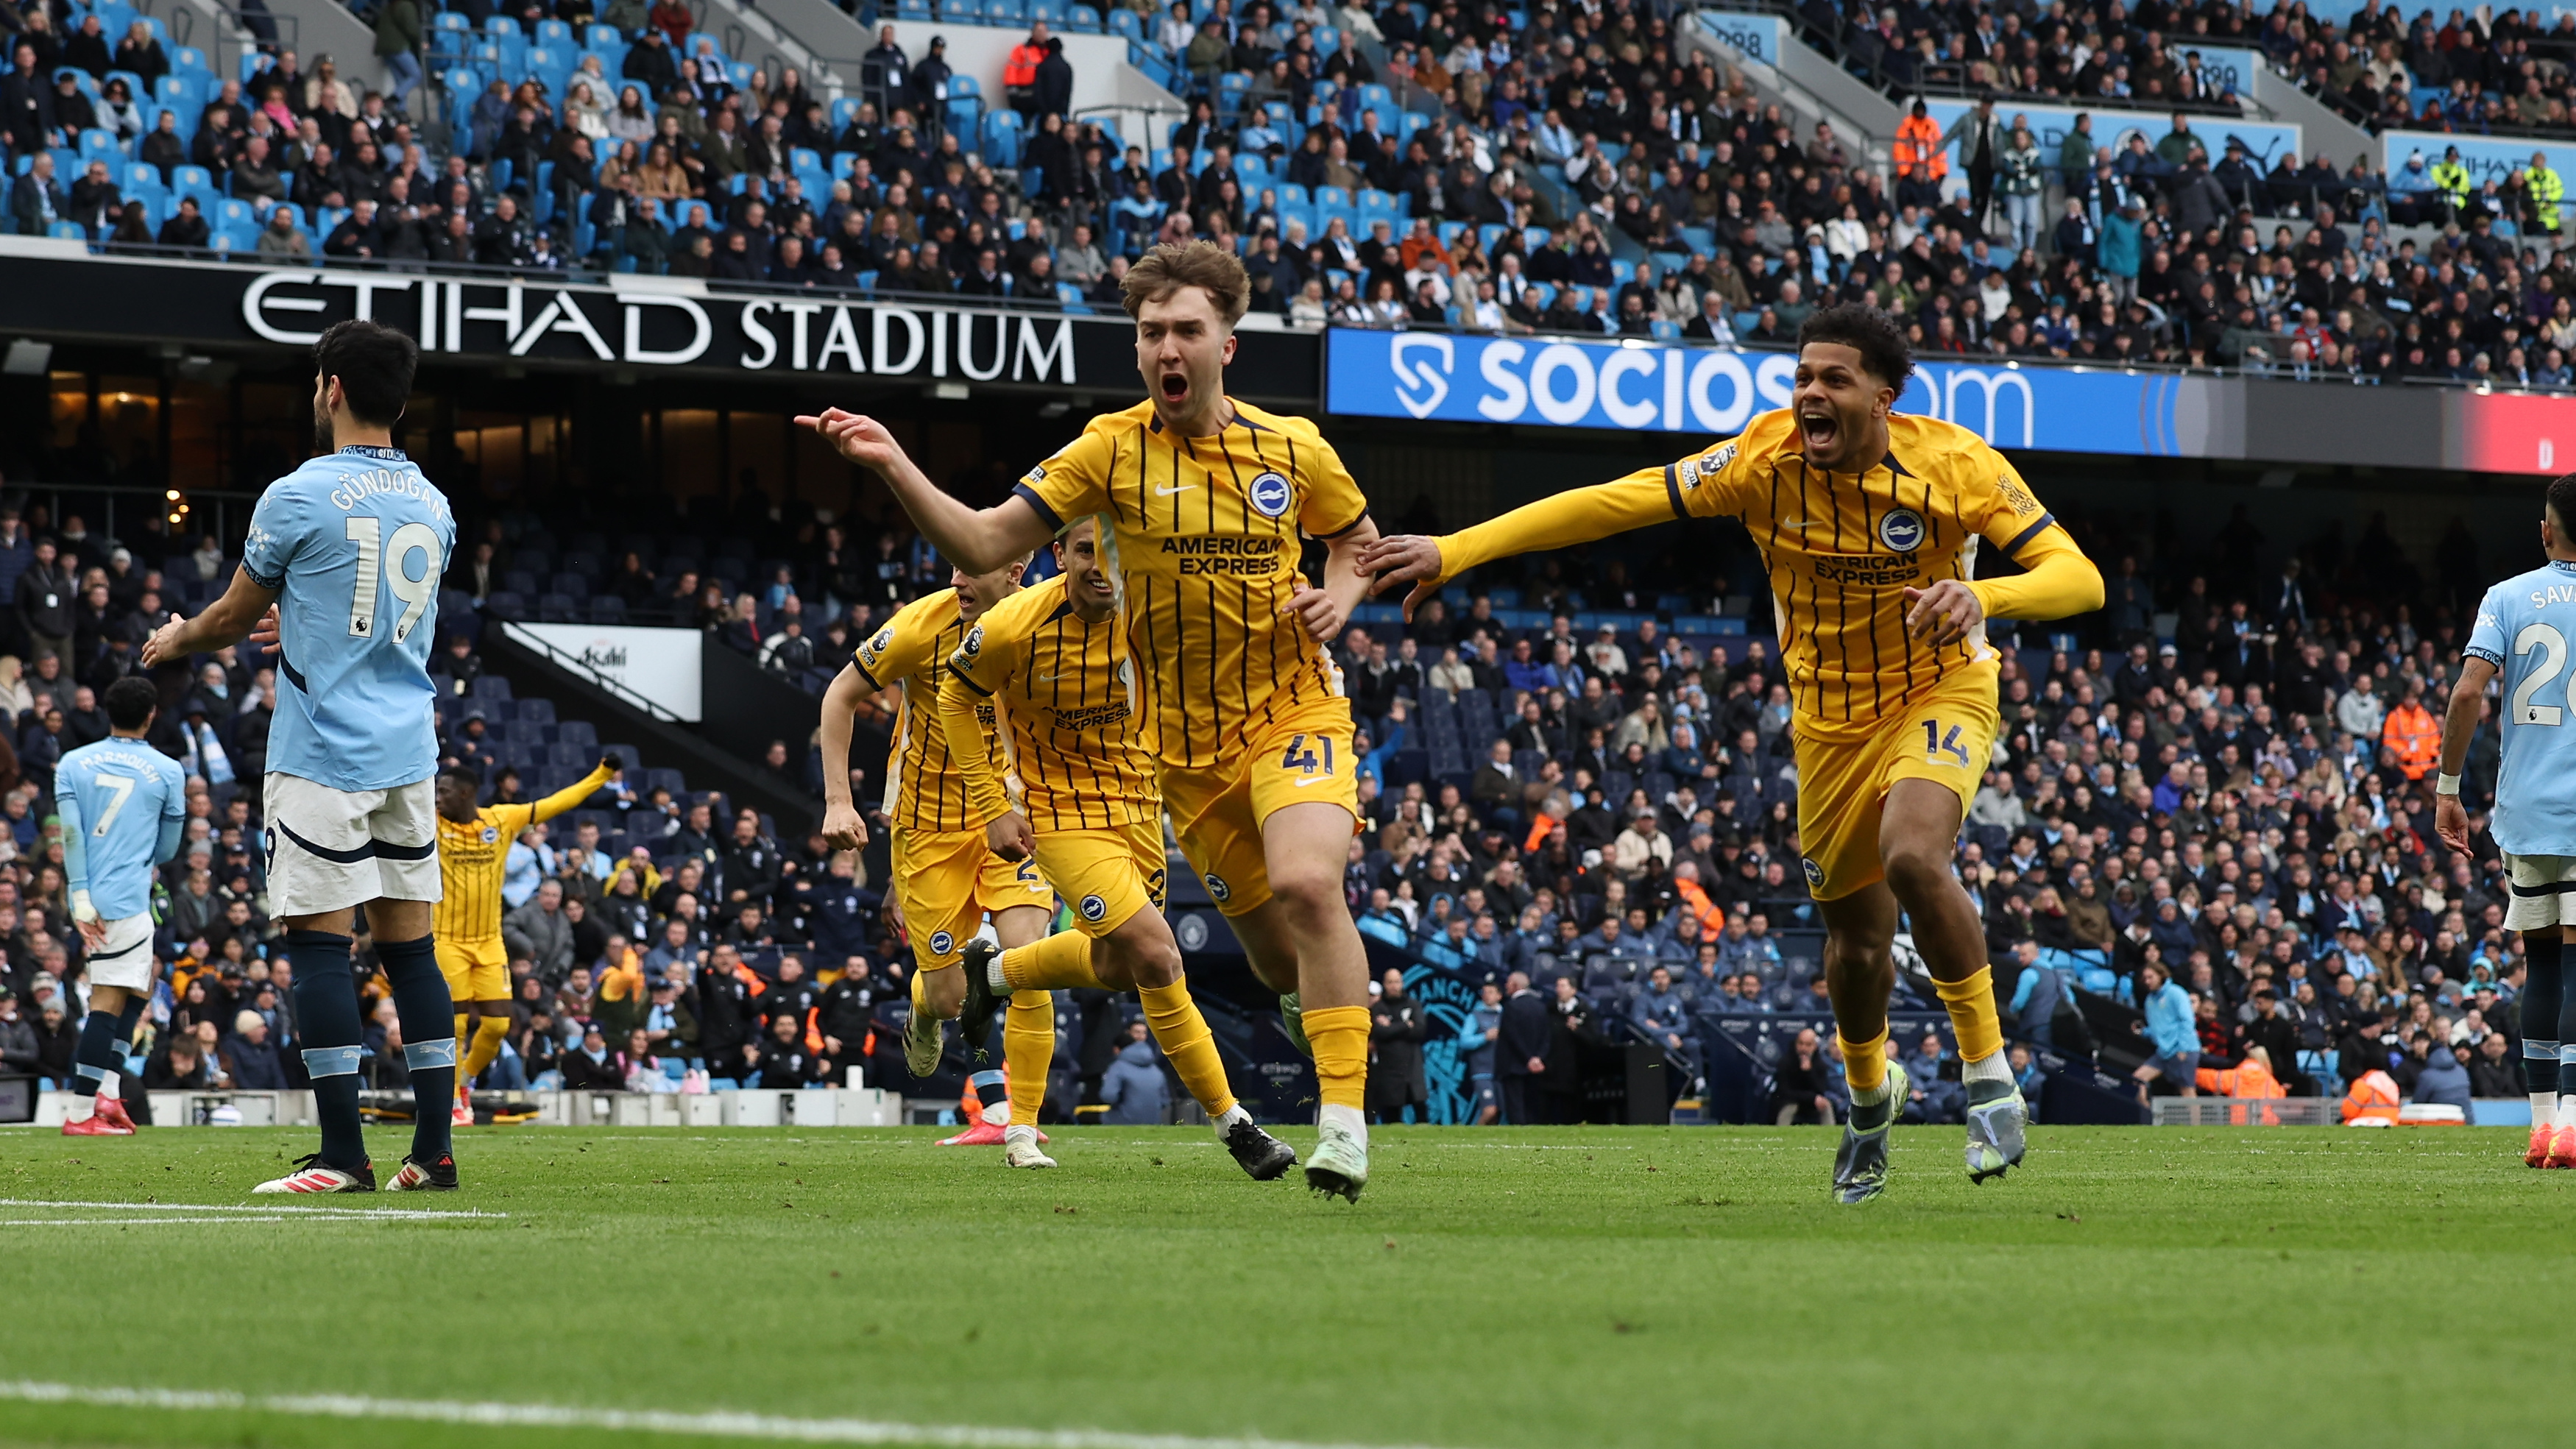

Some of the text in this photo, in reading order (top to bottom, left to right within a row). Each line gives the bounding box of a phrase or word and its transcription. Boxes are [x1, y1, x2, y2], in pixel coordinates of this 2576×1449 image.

[243, 273, 1078, 384] ETIHAD STADIUM
[331, 468, 445, 521] GÜNDOĞAN
[1161, 537, 1284, 555] AMERICAN
[1180, 555, 1279, 575] EXPRESS
[346, 517, 442, 645] 19
[1815, 561, 1920, 586] EXPRESS
[2530, 584, 2576, 609] SAV
[2512, 623, 2576, 726] 2
[1283, 734, 1334, 775] 41
[1922, 719, 1969, 768] 14
[79, 751, 160, 784] MARMOUSH
[93, 773, 135, 837] 7
